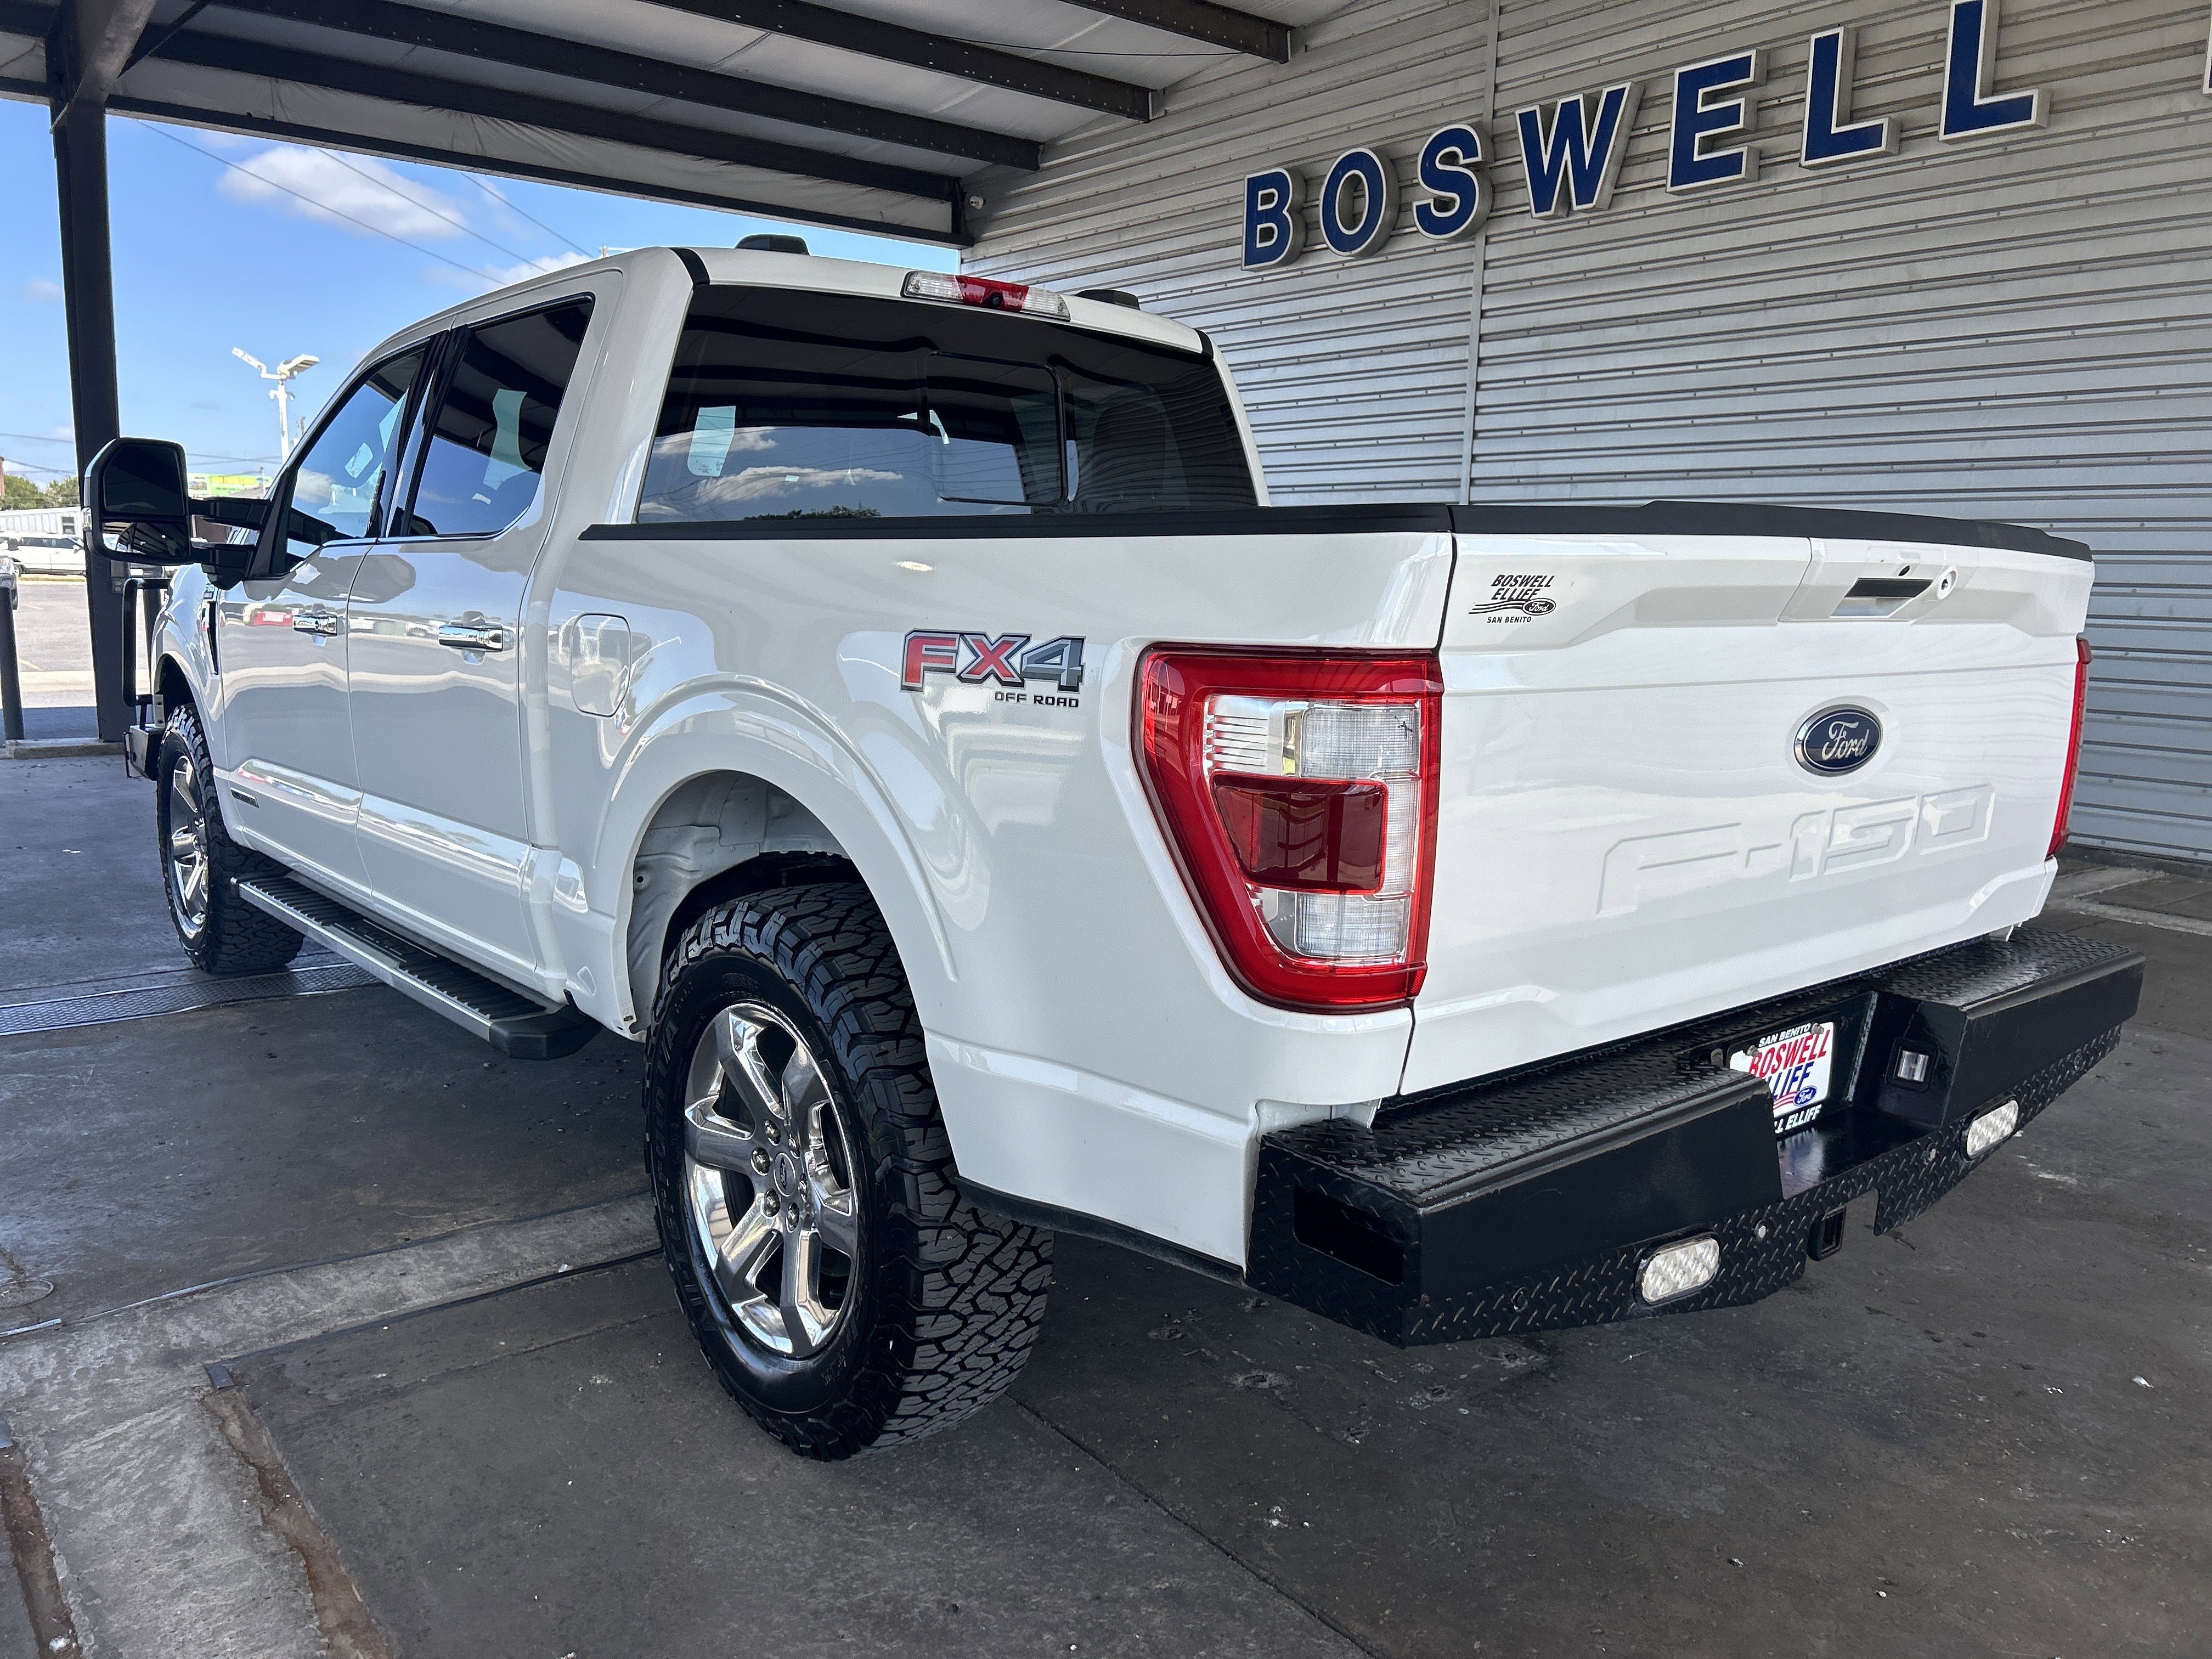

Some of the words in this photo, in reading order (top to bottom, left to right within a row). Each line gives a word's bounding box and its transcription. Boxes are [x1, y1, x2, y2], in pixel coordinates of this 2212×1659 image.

[1240, 0, 2045, 270] BOSWELL
[1491, 574, 1555, 588] BOSWELL
[1528, 601, 1548, 612] Ford
[901, 629, 1086, 693] FX4
[995, 691, 1028, 703] OFF
[1033, 694, 1080, 708] ROAD
[1821, 720, 1869, 760] Ford
[1595, 782, 1996, 916] F-150
[1758, 1034, 1779, 1048] SAN
[1778, 1023, 1812, 1042] BENITO
[1748, 1029, 1831, 1079] BOSWELL
[1797, 1090, 1814, 1105] Ford
[1785, 1104, 1822, 1131] ELLIFF
